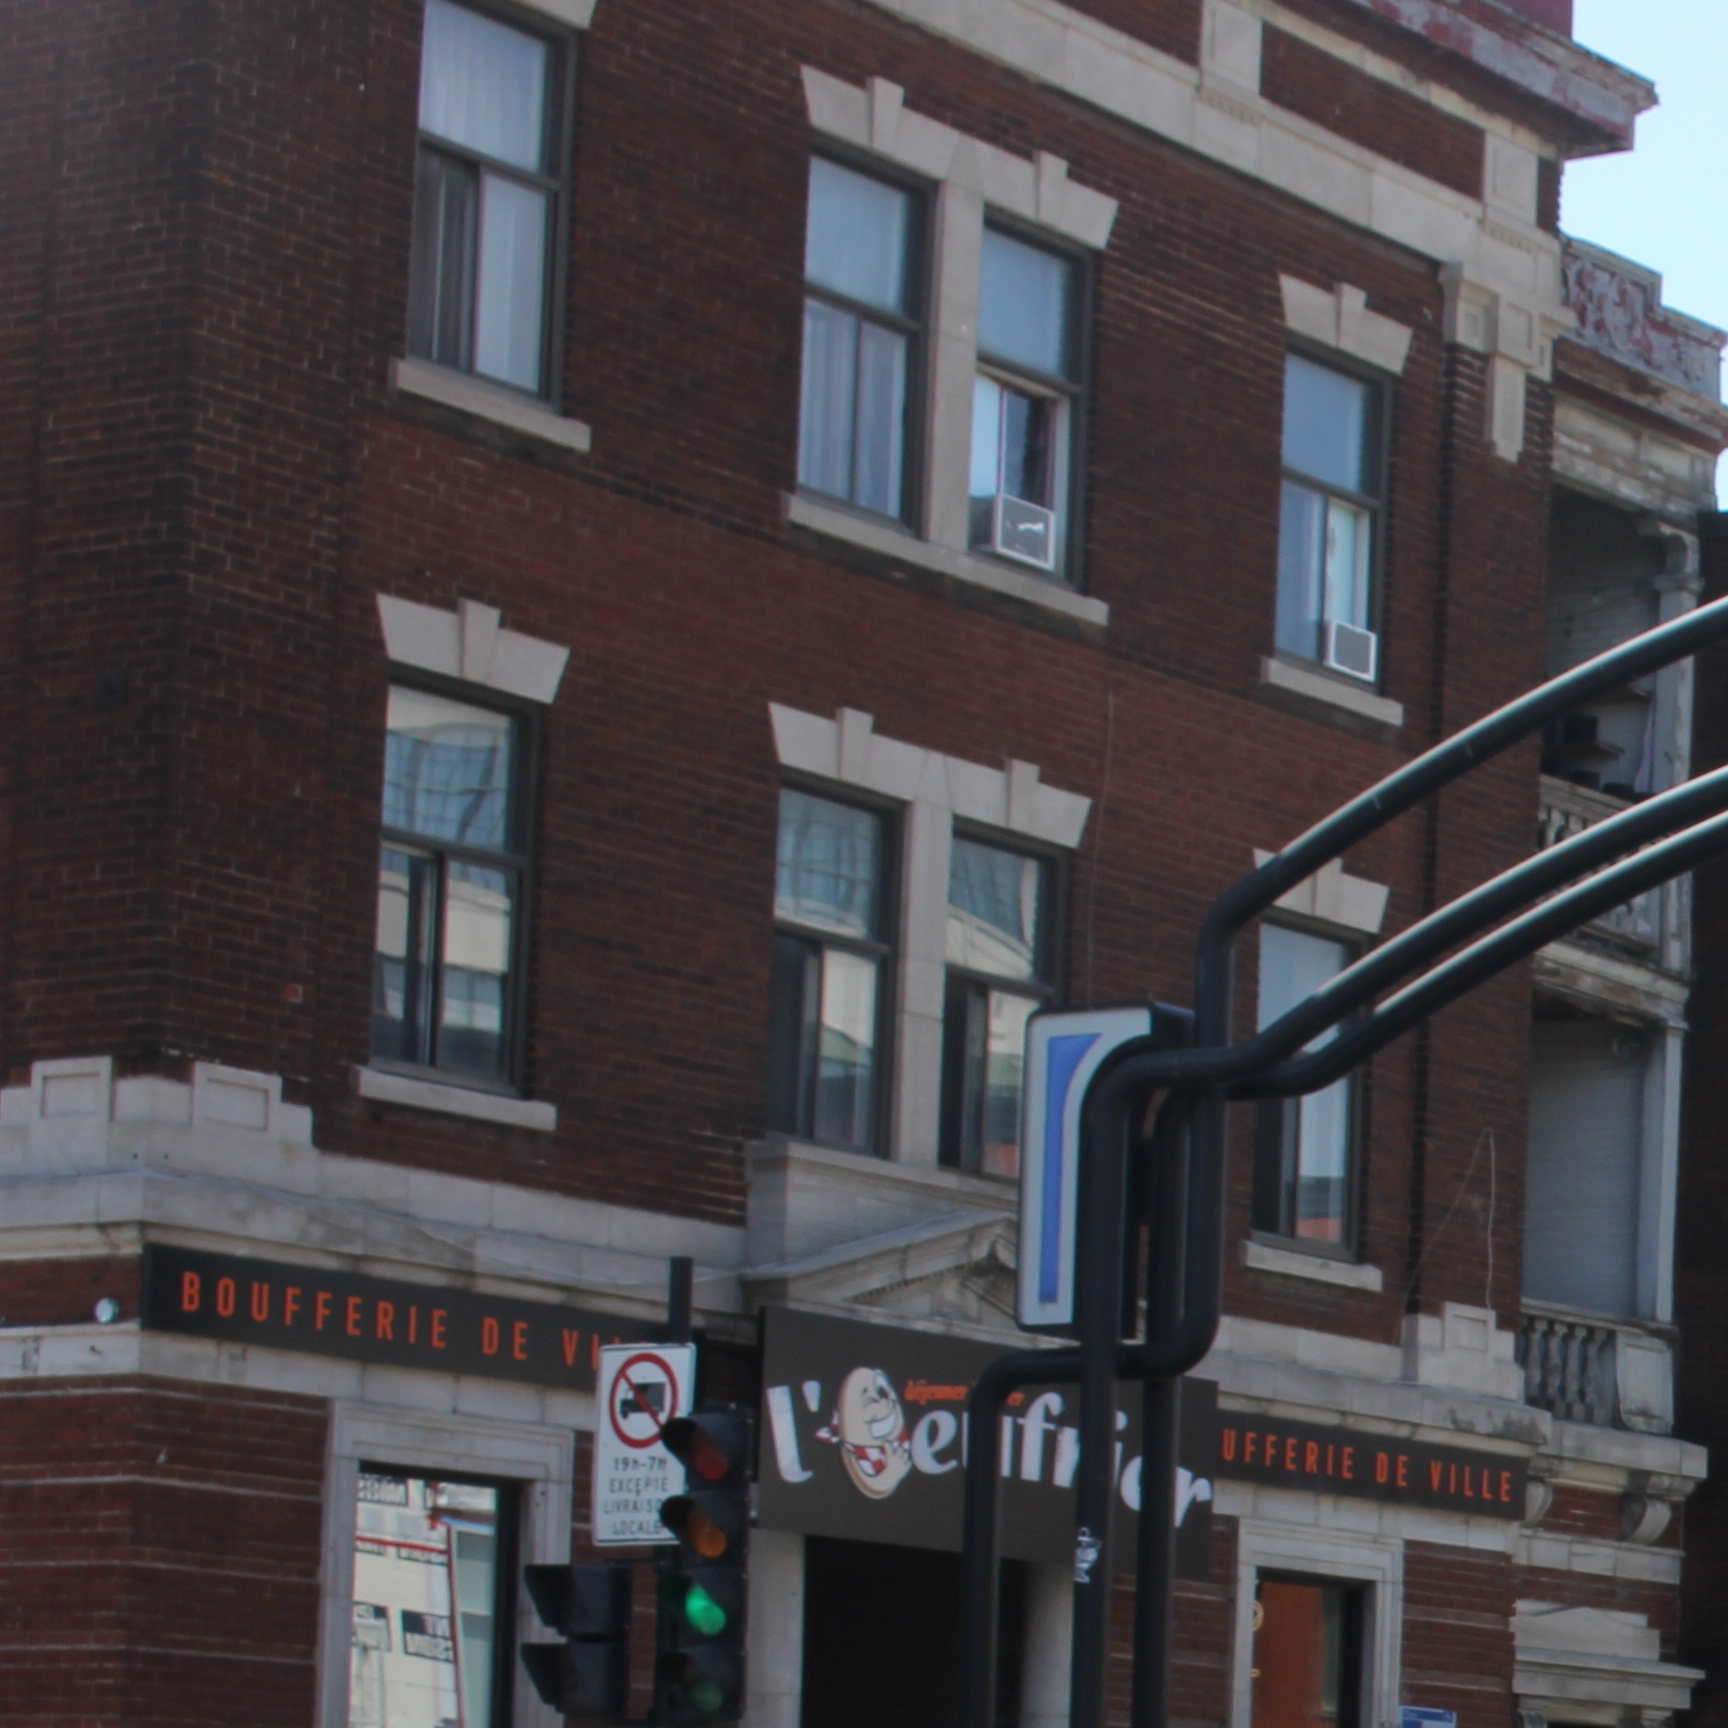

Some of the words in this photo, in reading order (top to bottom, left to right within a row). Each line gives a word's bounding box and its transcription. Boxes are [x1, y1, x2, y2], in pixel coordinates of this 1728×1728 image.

[181, 1270, 449, 1350] BOUFFERIE
[481, 1315, 529, 1361] DE
[1221, 1428, 1355, 1480] UFFERIE
[1375, 1451, 1409, 1487] DE
[1430, 1460, 1512, 1503] VILLE
